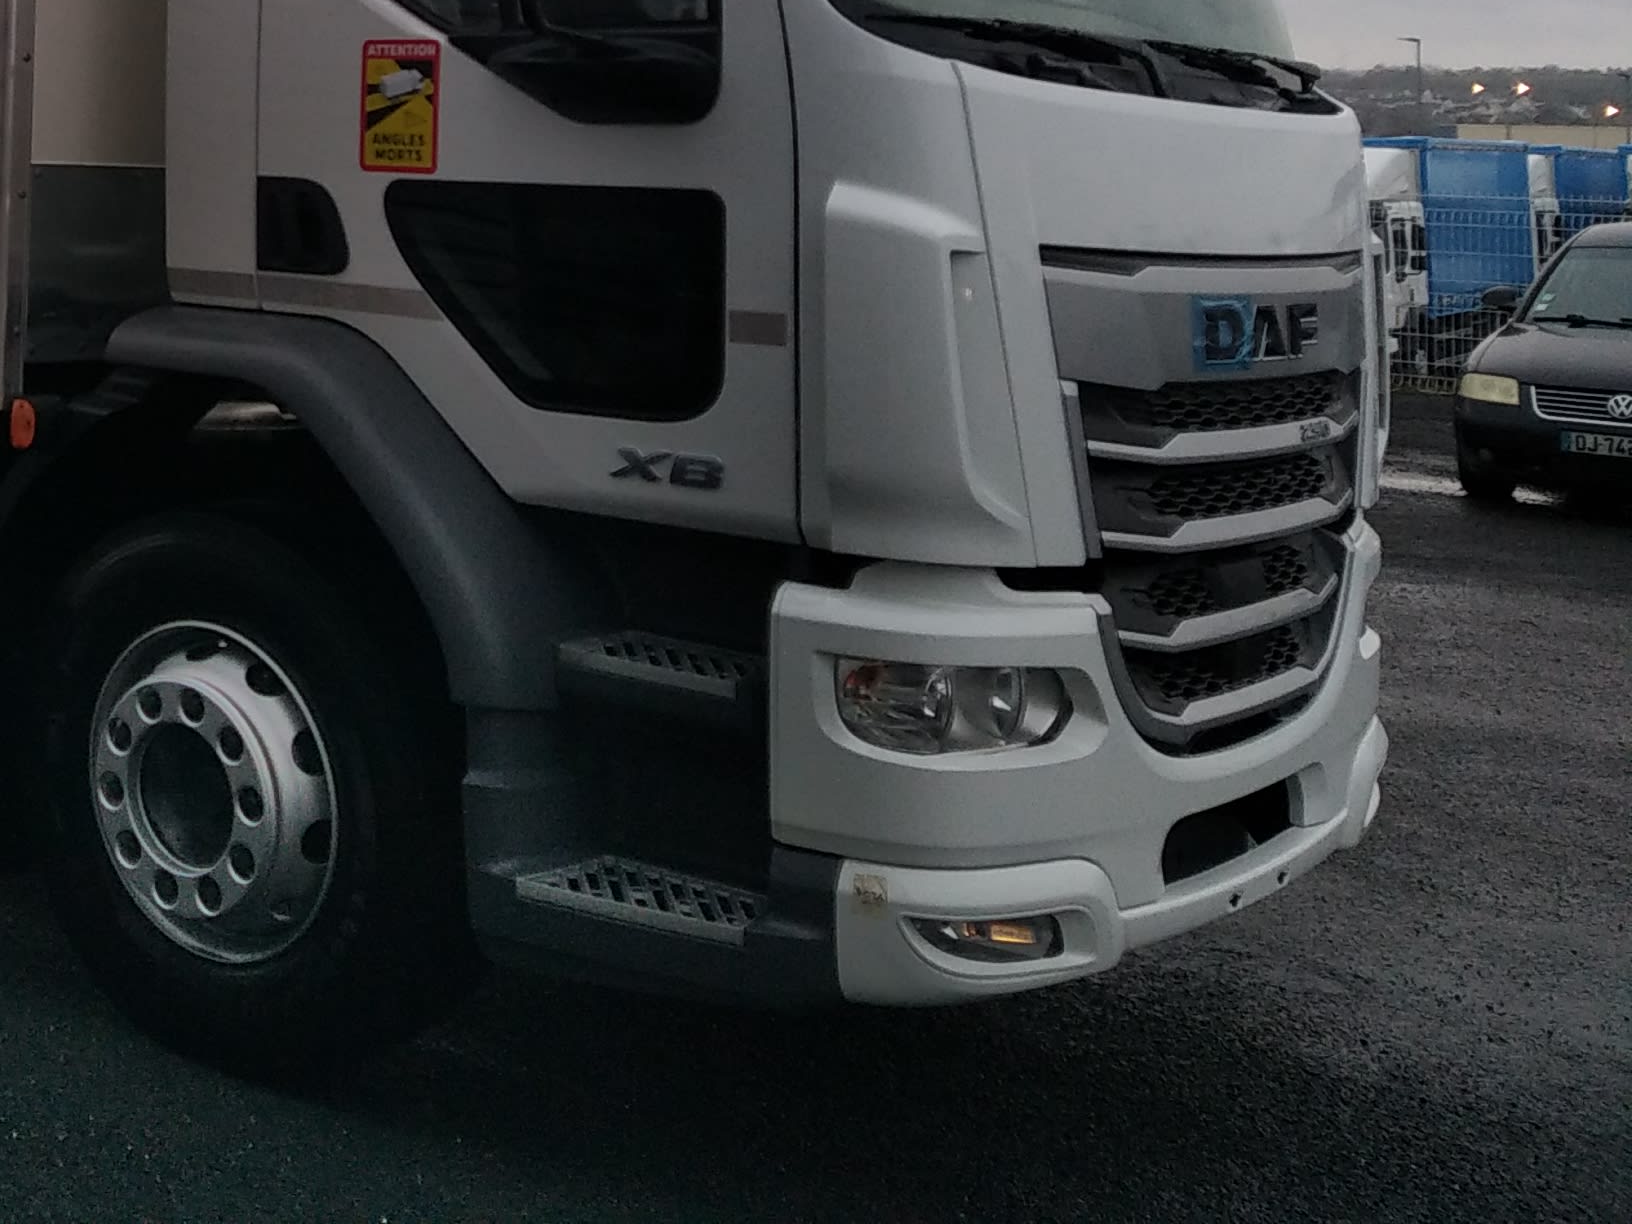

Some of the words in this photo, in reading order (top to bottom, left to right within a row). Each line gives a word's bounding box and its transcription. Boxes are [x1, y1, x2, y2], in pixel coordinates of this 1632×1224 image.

[367, 43, 436, 57] ATTENTION
[372, 133, 425, 147] ANGLES
[375, 148, 423, 162] MORTS
[1202, 301, 1318, 362] DAF
